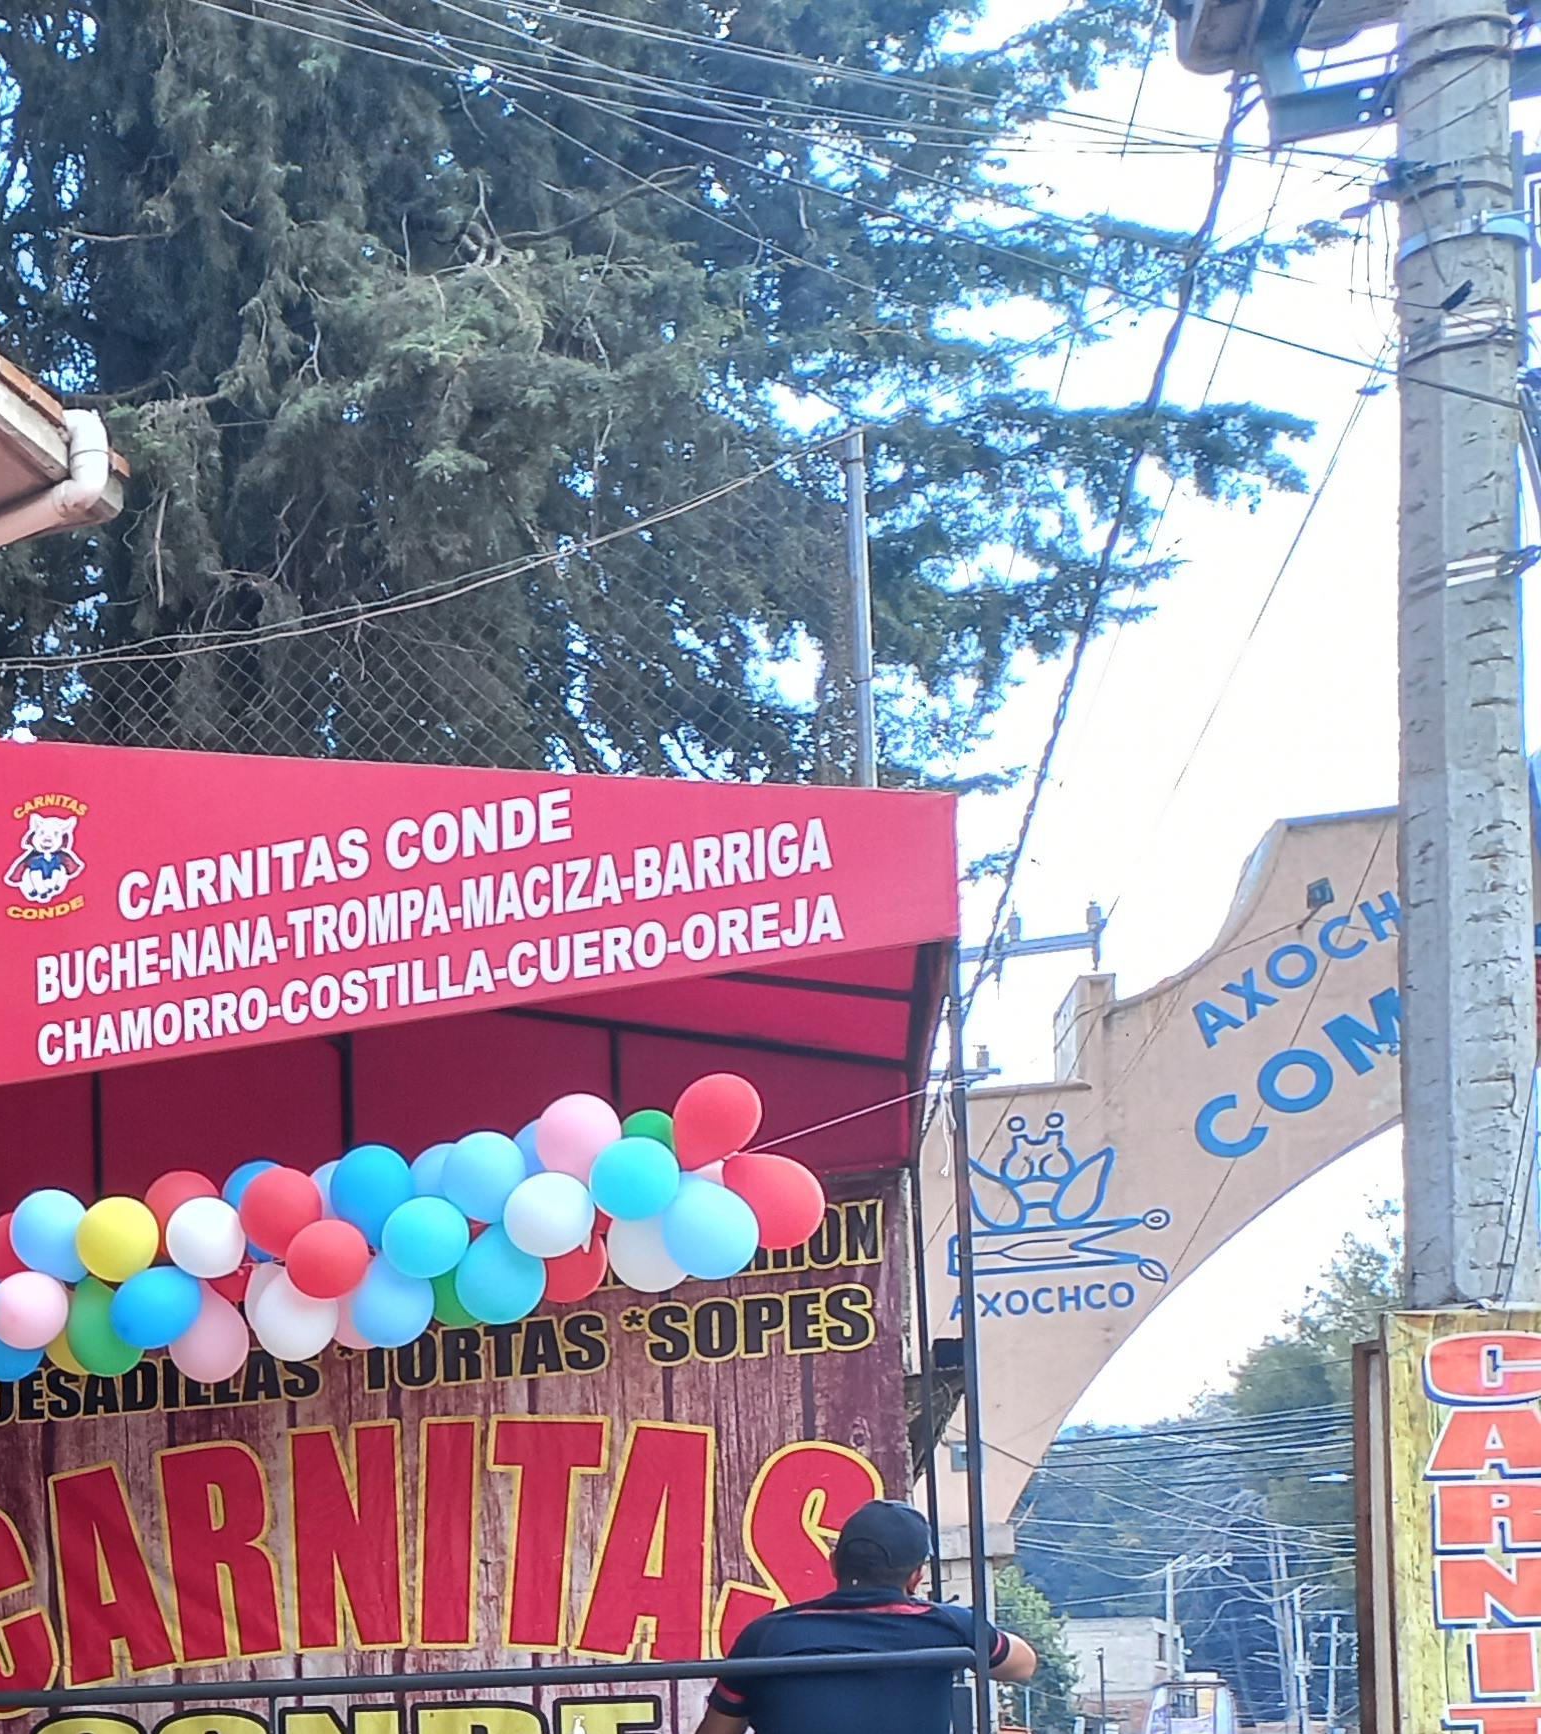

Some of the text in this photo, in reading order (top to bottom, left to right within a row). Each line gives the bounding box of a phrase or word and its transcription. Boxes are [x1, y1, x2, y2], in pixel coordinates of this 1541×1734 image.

[13, 794, 88, 819] CARNITAS
[118, 788, 572, 921] CARNITAS CONDE
[6, 895, 85, 919] CONDE
[36, 817, 832, 1004] BUCHE-NANA-TROMPA-MACIZA-BARRIGA
[36, 894, 845, 1067] CHAMORRO-COSTILLA-CUERO-OREJA
